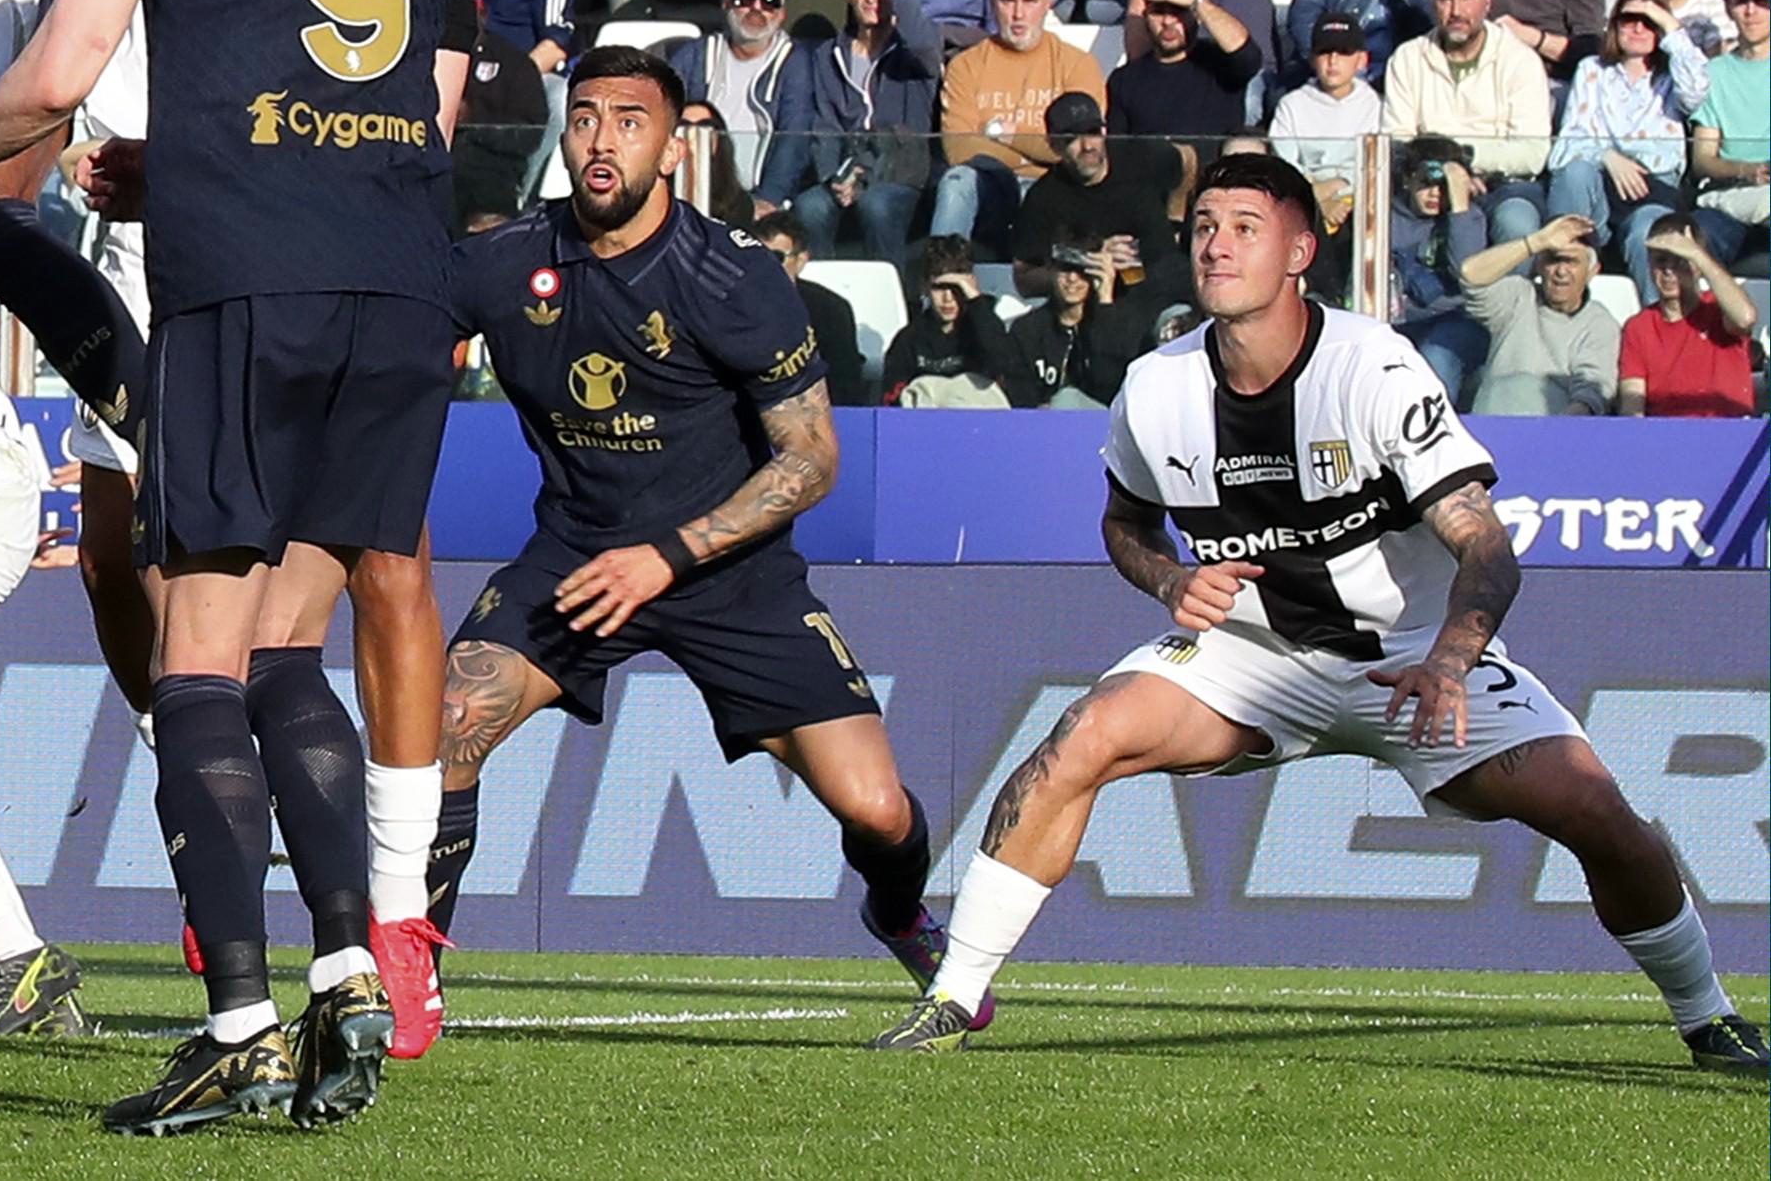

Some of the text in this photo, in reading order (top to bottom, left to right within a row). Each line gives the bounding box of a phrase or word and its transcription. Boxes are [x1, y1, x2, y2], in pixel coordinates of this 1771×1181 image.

[288, 101, 427, 151] Cygame
[1035, 359, 1058, 386] 10
[611, 412, 656, 437] the
[1215, 454, 1295, 473] ADMIRAL
